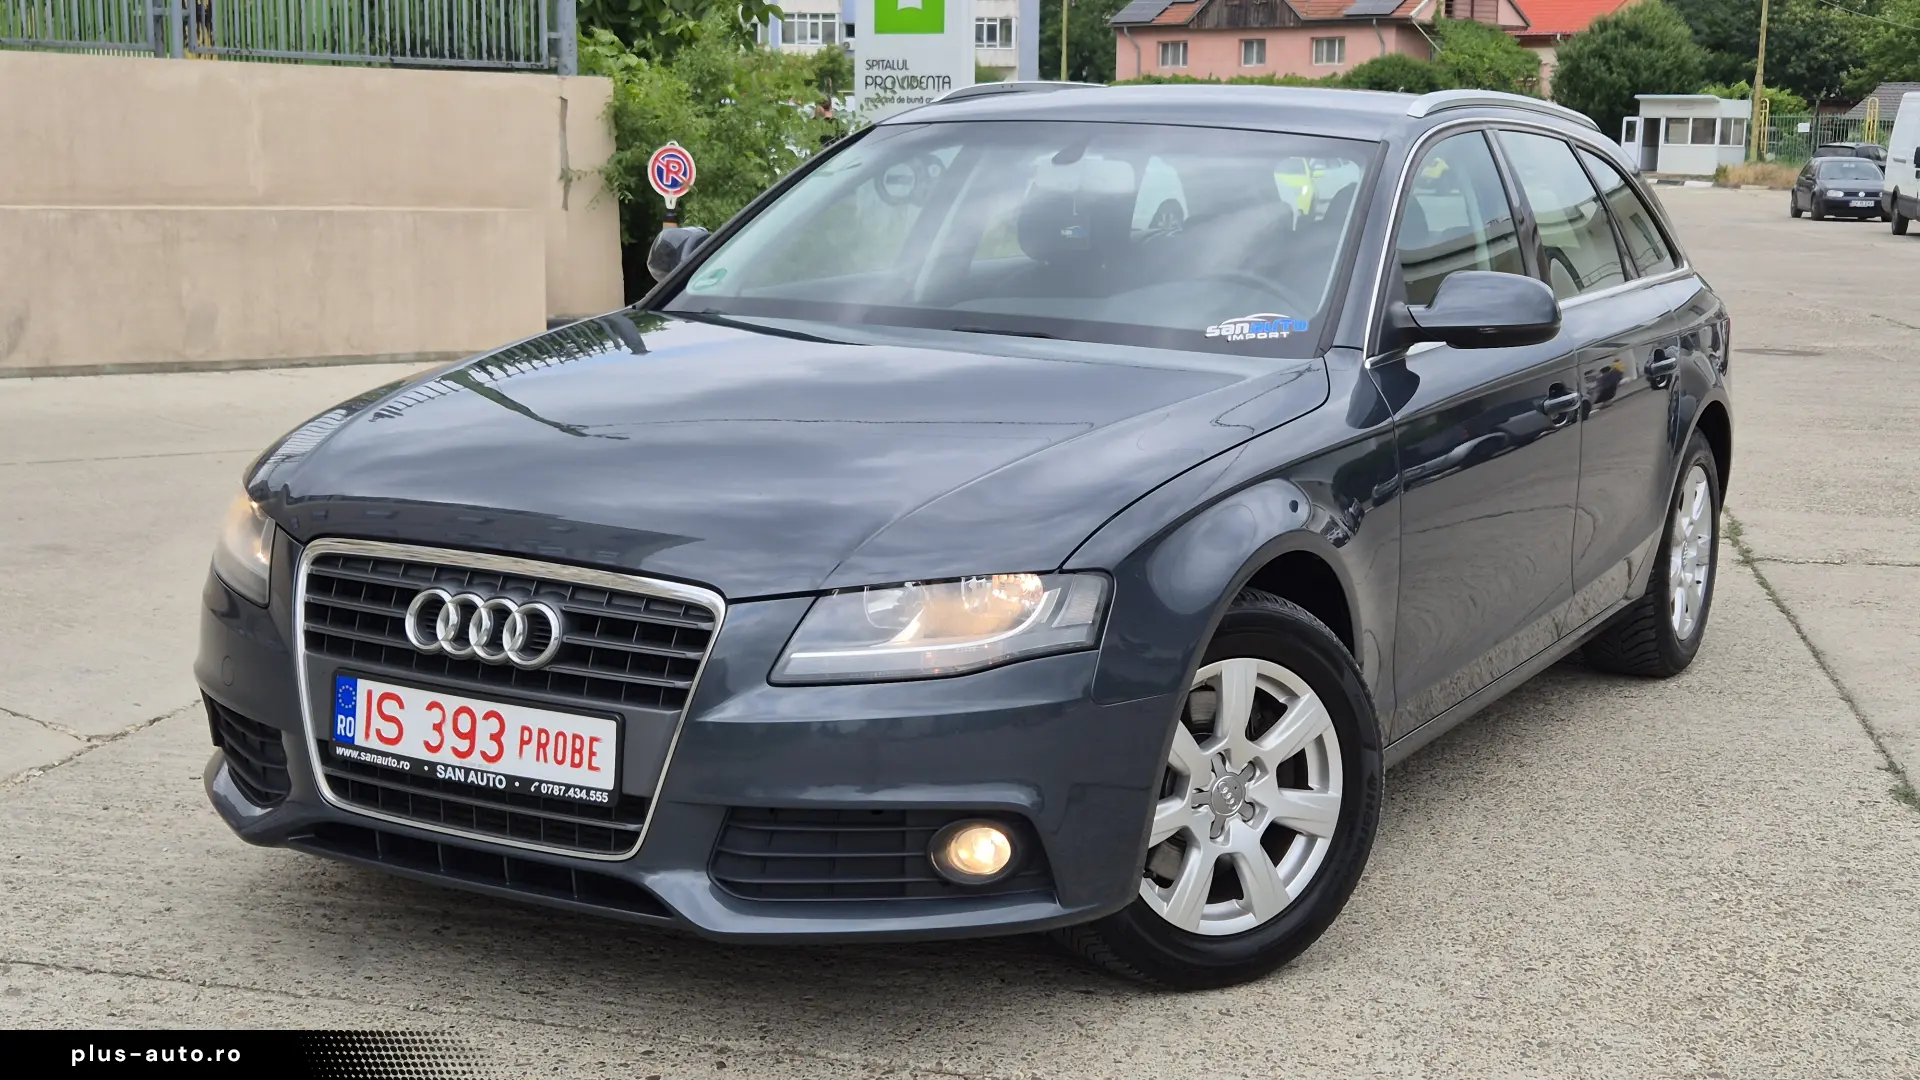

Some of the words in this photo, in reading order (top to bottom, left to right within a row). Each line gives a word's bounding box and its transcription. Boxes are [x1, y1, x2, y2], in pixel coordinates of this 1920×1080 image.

[865, 59, 909, 70] SPITALUL
[1227, 331, 1289, 341] IMPORT
[336, 714, 355, 737] RO
[364, 689, 405, 746] IS
[423, 700, 506, 764] 393
[518, 725, 603, 772] PROBE
[336, 746, 410, 770] www.sanauto.ro
[436, 764, 464, 781] SAN
[467, 771, 507, 789] AUTO
[541, 783, 609, 803] 0787.434.555
